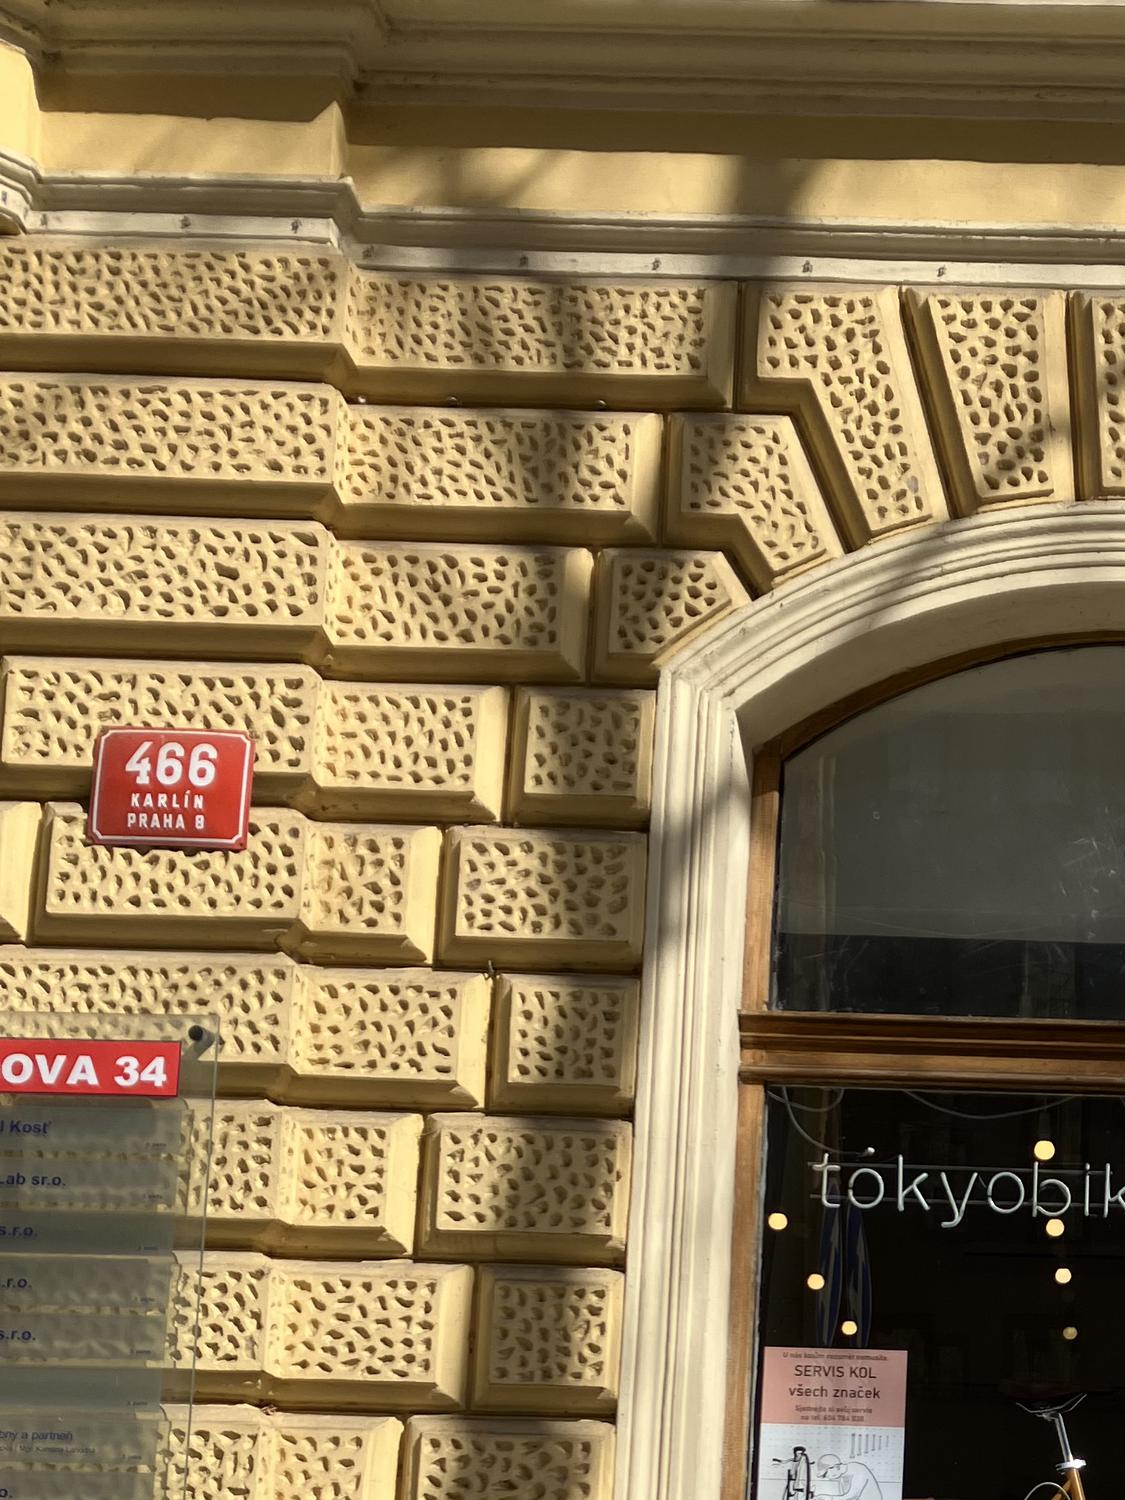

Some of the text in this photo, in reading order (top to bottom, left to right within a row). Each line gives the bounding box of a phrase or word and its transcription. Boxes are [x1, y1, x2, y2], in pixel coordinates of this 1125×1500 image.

[125, 741, 218, 787] 466
[131, 790, 204, 810] KARLÍN
[127, 812, 205, 830] PRAHA 8
[1, 1053, 167, 1087] OVA 34
[794, 1364, 877, 1379] SERVIS KOL
[788, 1384, 881, 1399] všech značek
